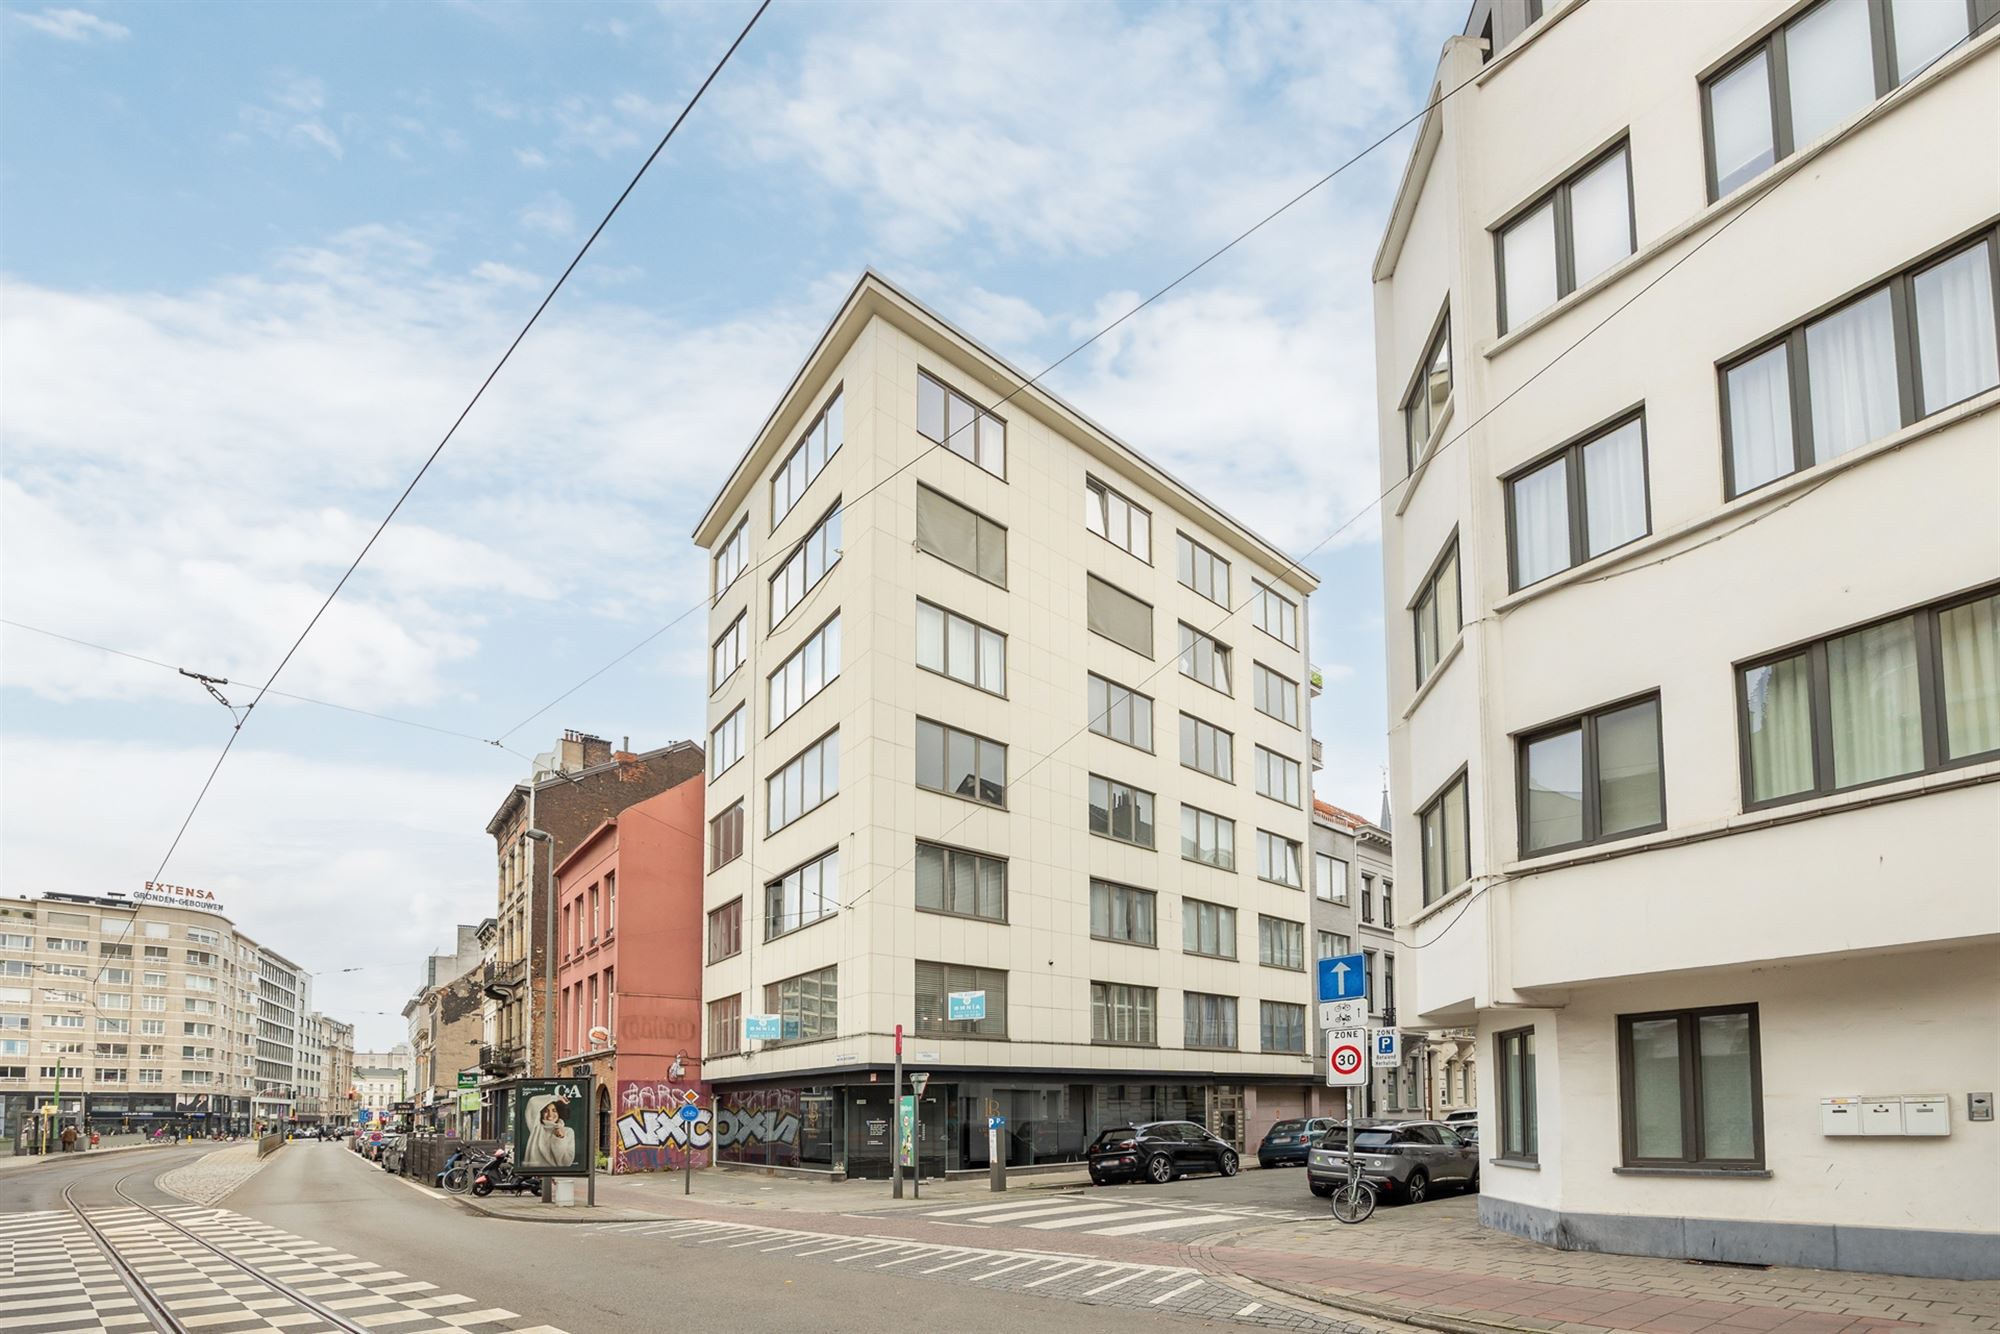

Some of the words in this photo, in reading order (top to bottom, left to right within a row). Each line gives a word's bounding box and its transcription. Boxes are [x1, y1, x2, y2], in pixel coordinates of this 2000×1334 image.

[145, 881, 215, 900] EXTENSA
[133, 891, 224, 911] GRONDEN-GEBOUWEN
[1334, 1031, 1359, 1039] ZONE
[1382, 1038, 1391, 1049] P
[1337, 1054, 1356, 1066] 30
[554, 1085, 582, 1099] C&A
